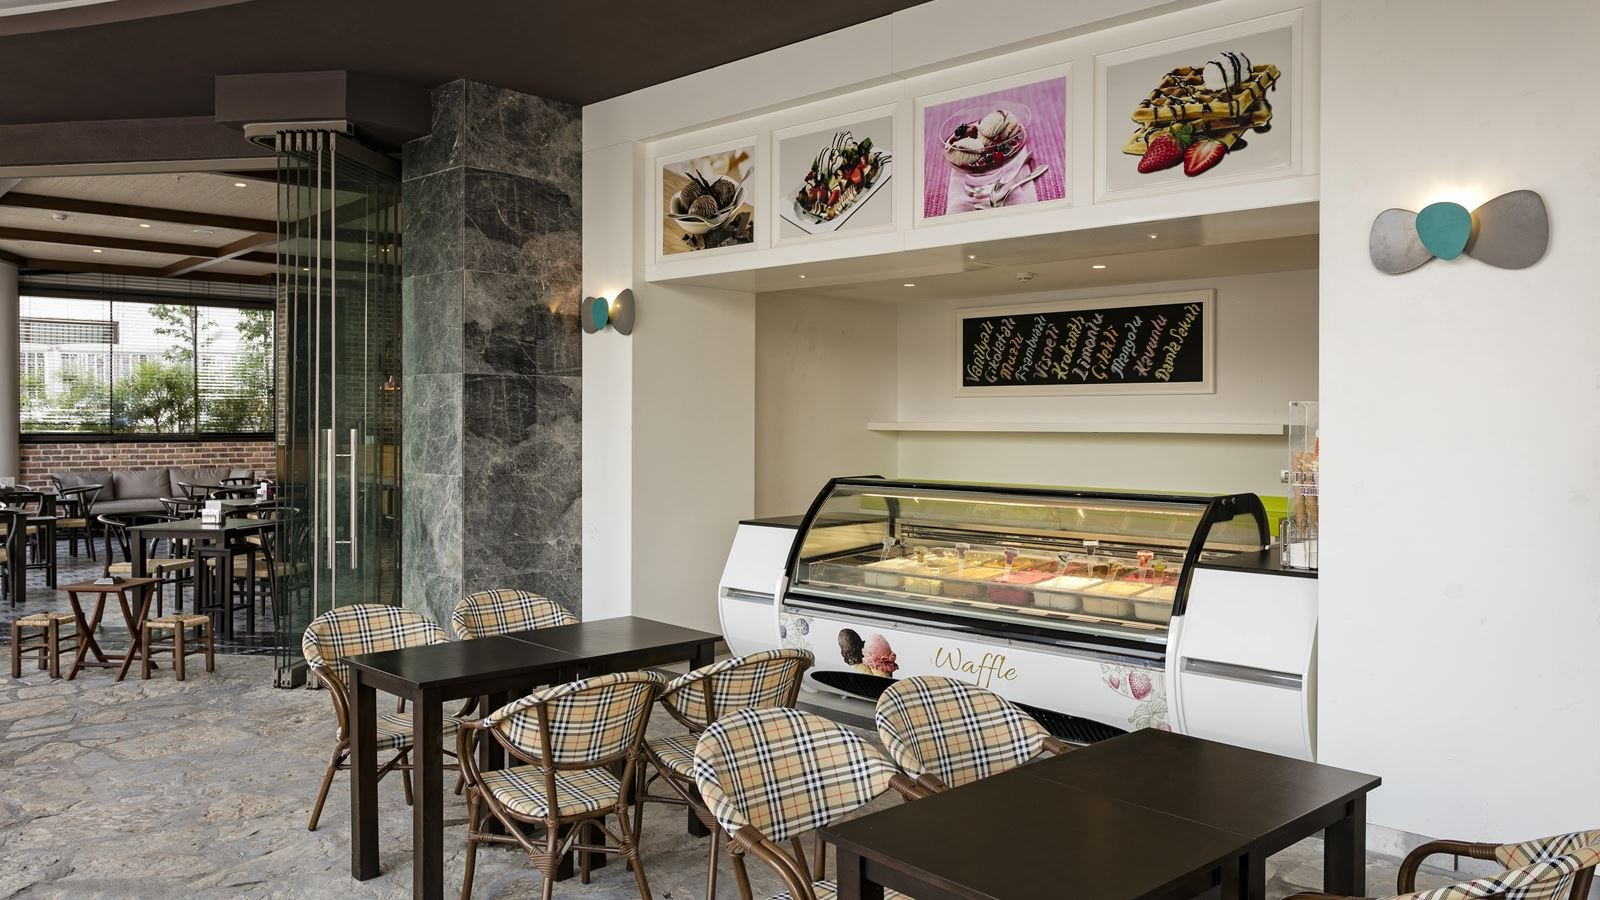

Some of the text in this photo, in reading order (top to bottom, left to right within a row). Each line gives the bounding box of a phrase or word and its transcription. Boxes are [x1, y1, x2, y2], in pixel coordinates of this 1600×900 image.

[1072, 313, 1104, 381] Limonlu
[1111, 315, 1143, 380] Mangolu
[1133, 314, 1167, 377] Kavunlu
[1155, 341, 1181, 382] Damla
[935, 647, 1018, 688] Waffle
